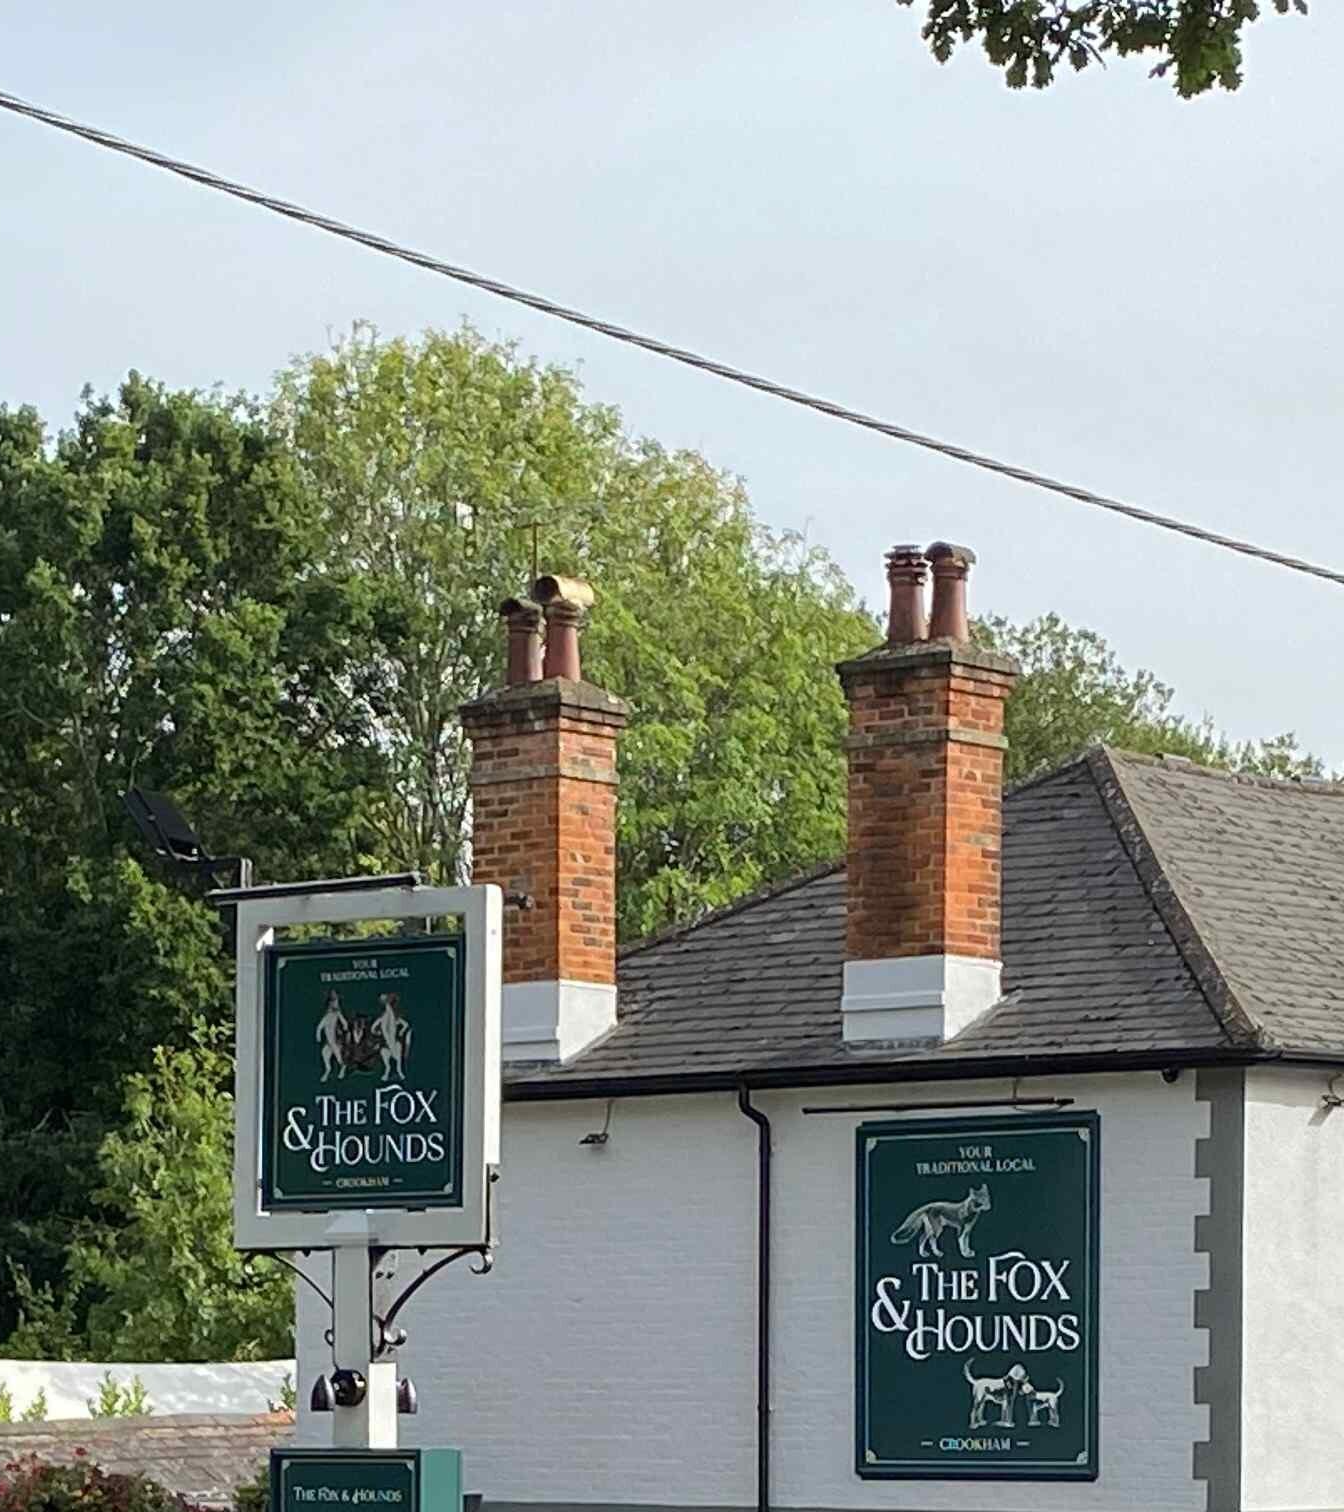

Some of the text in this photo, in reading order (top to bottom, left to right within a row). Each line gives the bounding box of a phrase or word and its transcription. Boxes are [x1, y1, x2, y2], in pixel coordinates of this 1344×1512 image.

[380, 967, 410, 979] LOCAL
[315, 1084, 438, 1127] THE FOX
[283, 1106, 444, 1172] & HOUNDS
[959, 1145, 993, 1160] YOUR
[916, 1157, 1036, 1175] TRADITIONAL LOCAL
[912, 1251, 1071, 1301] THE FOX
[871, 1276, 1080, 1360] & HOUNDS
[939, 1437, 1011, 1452] CROOKHAM
[293, 1487, 403, 1505] THE FOX & HOUNDS
